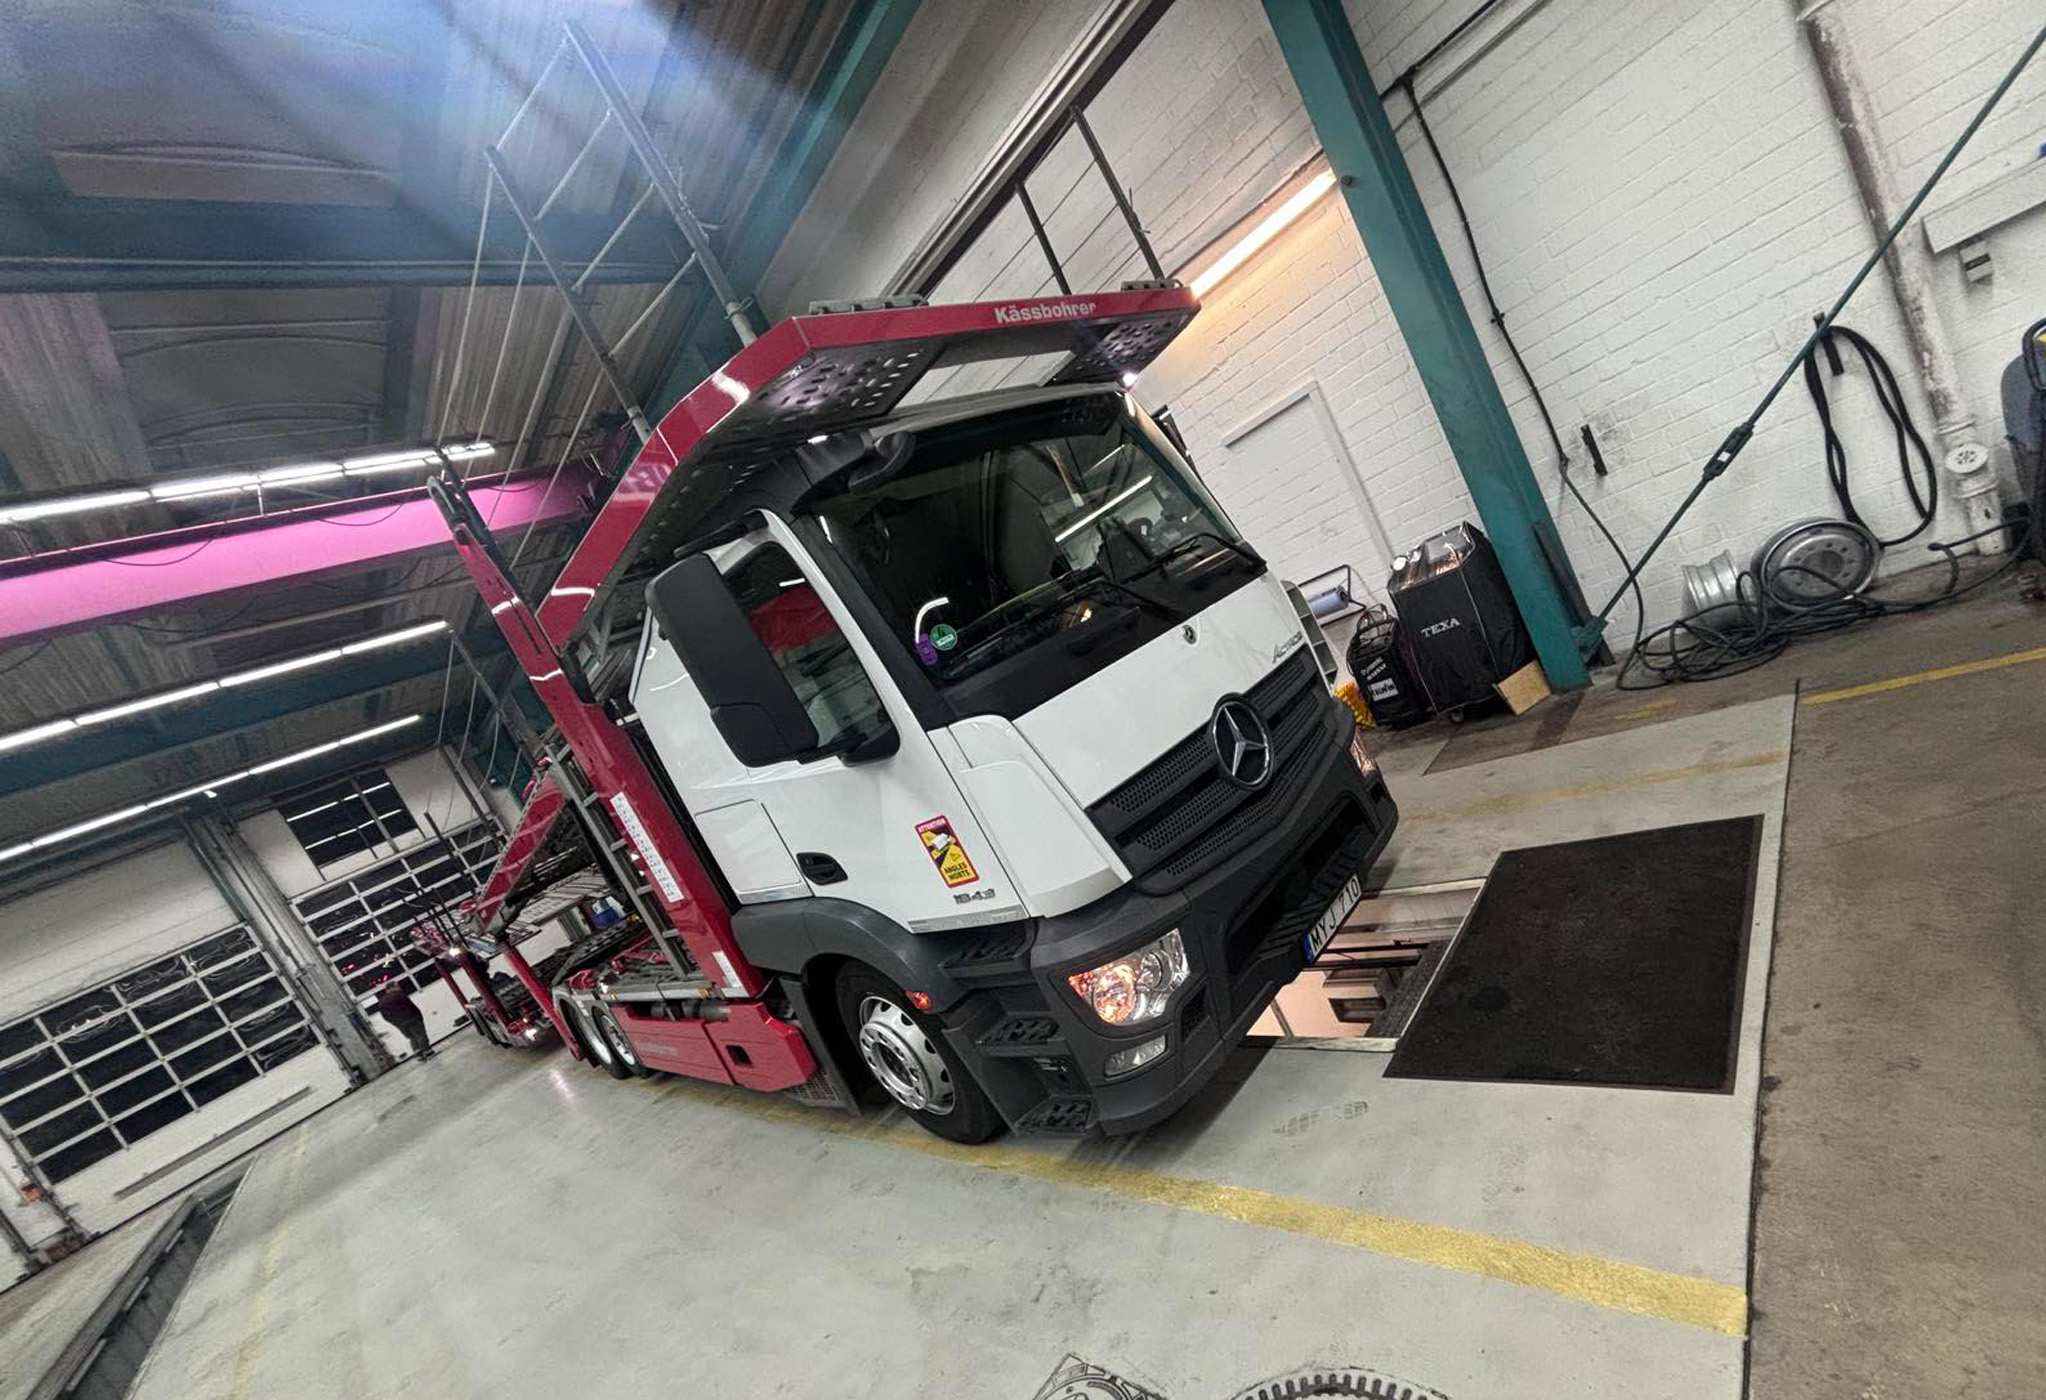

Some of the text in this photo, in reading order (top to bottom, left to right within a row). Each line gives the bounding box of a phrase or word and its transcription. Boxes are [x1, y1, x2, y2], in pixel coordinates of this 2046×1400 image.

[994, 301, 1097, 325] Kässbohrer
[1420, 617, 1461, 638] TEXA
[943, 862, 968, 875] ANGLES
[947, 869, 971, 881] MORTS
[1338, 878, 1360, 913] 710
